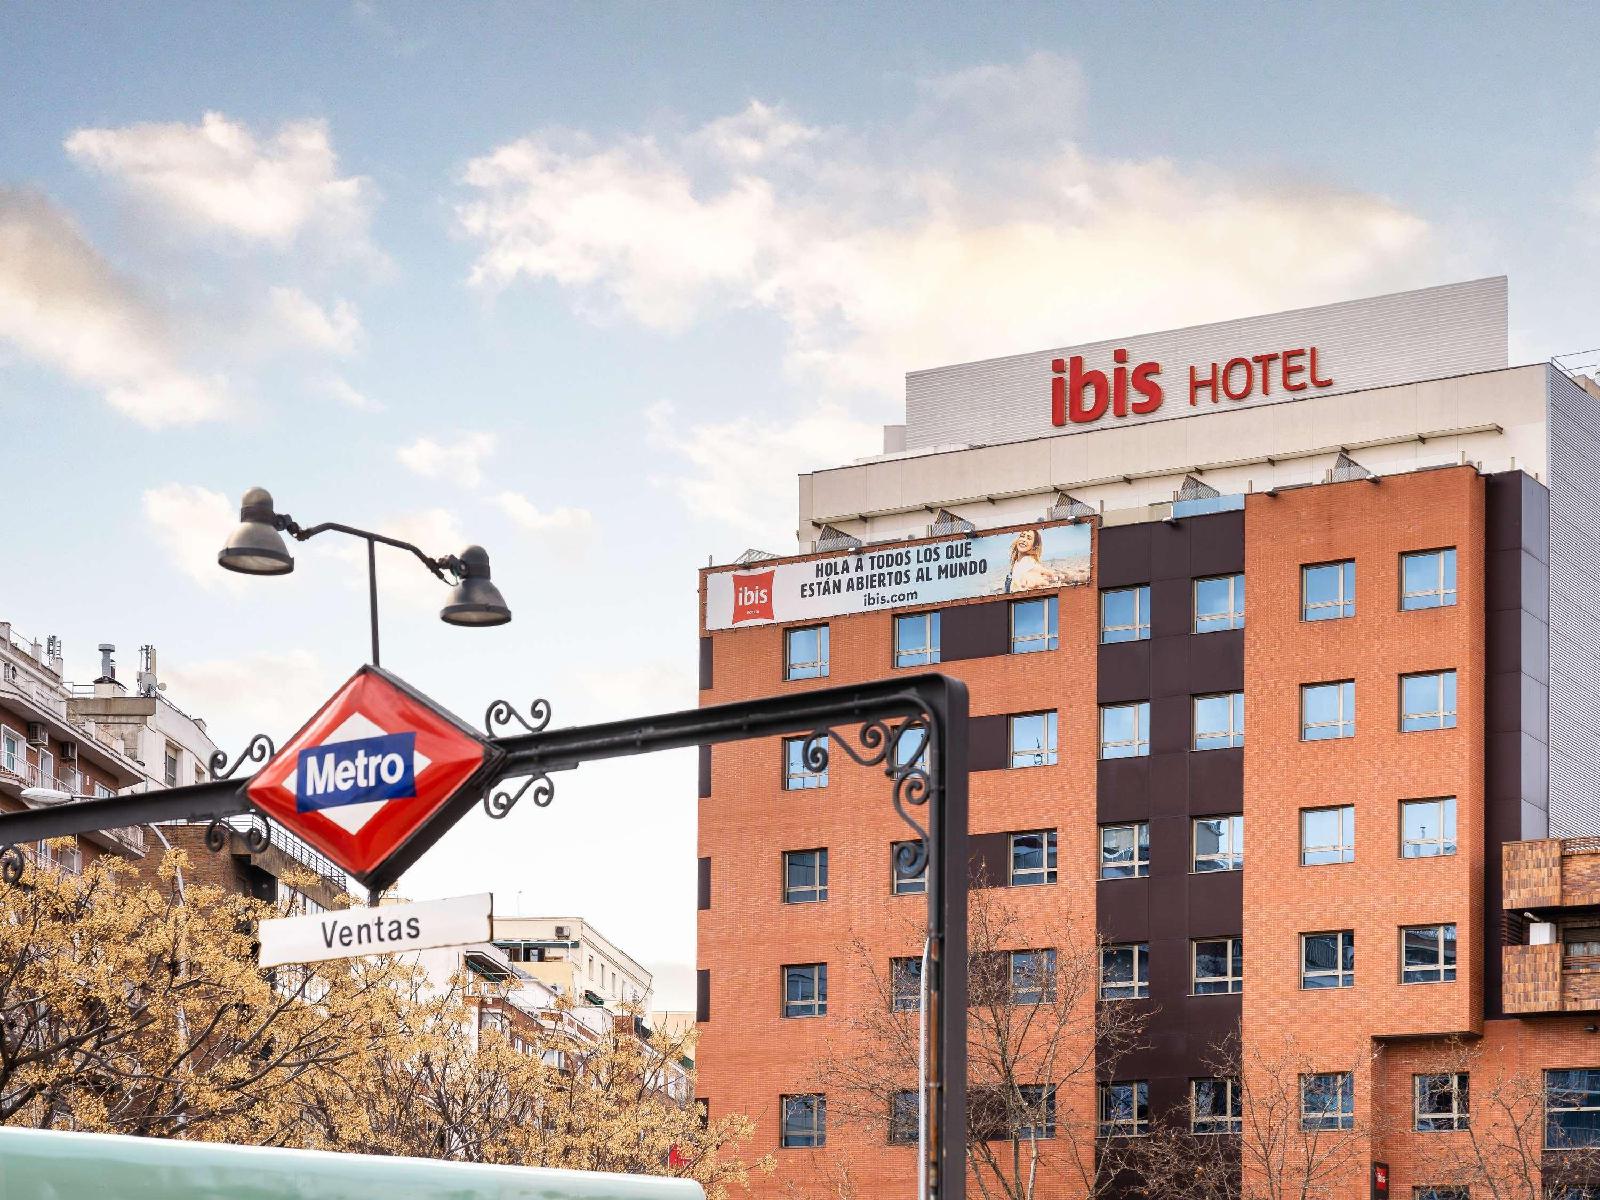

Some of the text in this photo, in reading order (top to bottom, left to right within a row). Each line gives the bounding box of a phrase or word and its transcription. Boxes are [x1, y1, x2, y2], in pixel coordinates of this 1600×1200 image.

[1051, 346, 1334, 427] ibis HOTEL
[800, 558, 988, 598] ESTÁN ABIERTOS AL MUNDO
[815, 541, 972, 578] HOLA A TODOS LOS QUE
[738, 585, 768, 607] ibis
[863, 590, 918, 607] ibis.com
[305, 749, 405, 797] Metro
[321, 916, 421, 949] Ventas
